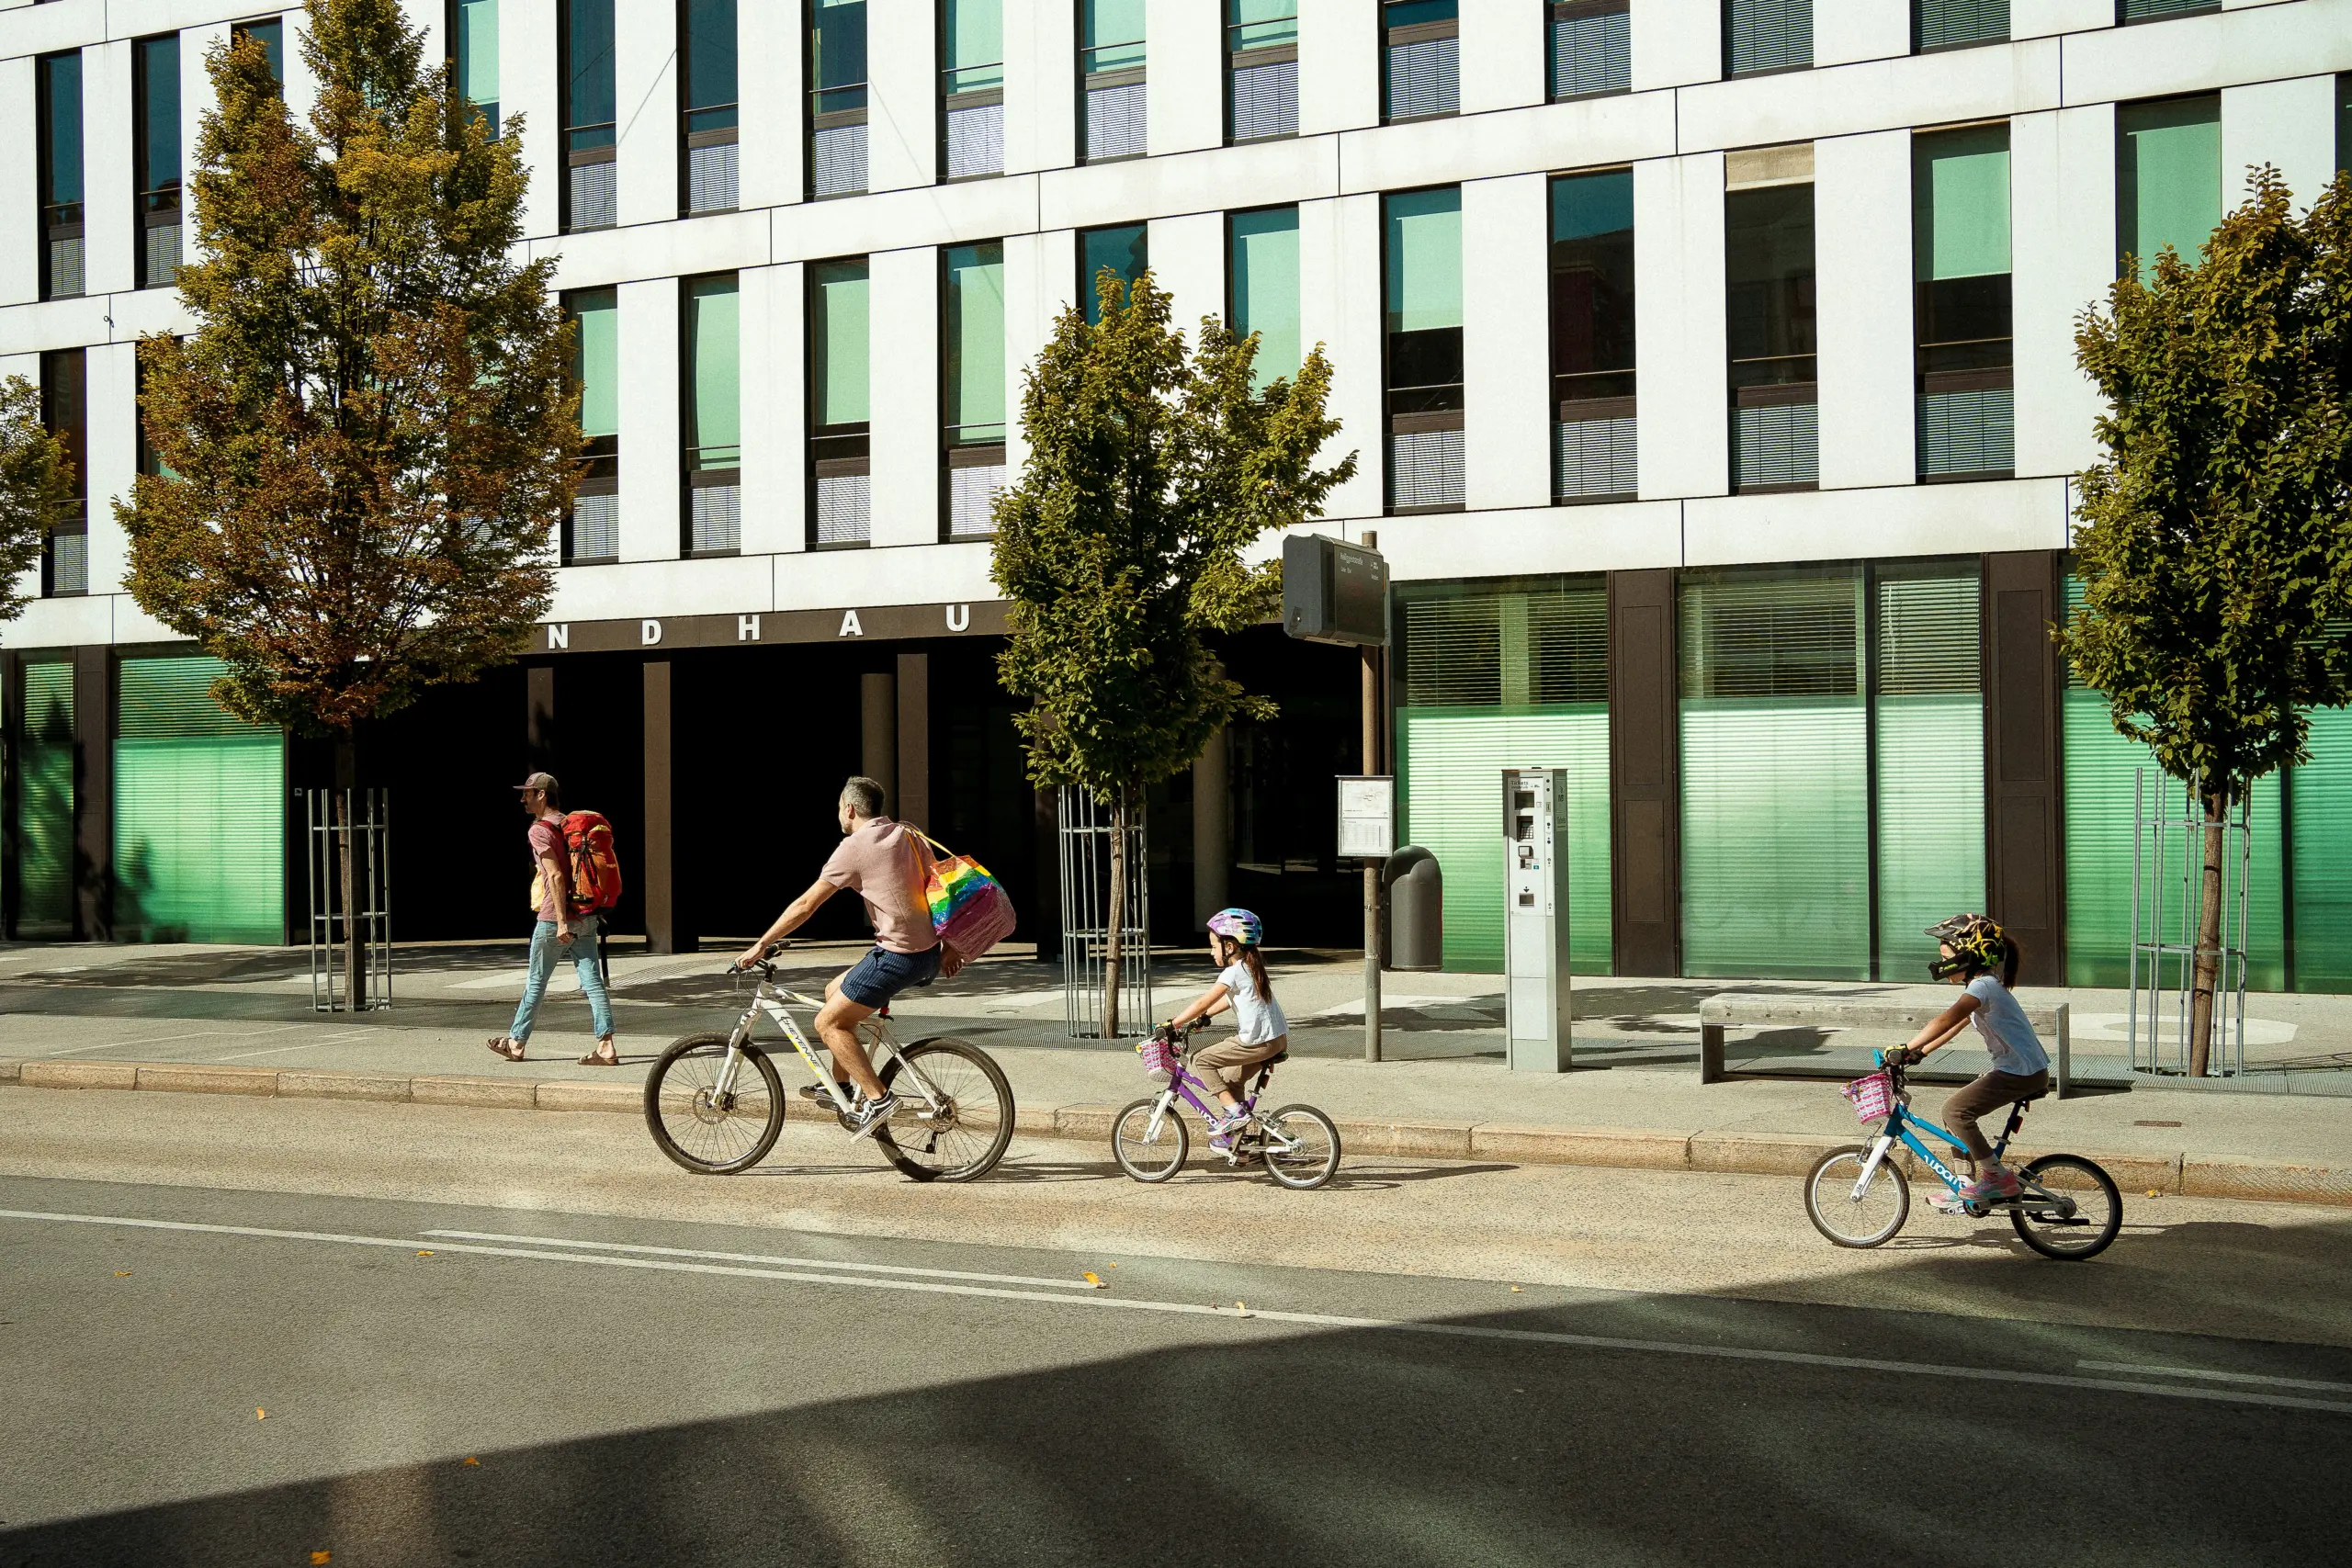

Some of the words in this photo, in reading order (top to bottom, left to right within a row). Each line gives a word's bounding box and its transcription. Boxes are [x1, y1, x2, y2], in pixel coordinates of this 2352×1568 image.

[548, 604, 970, 649] NDHAU
[781, 1016, 821, 1068] CHEYENNE
[1196, 1106, 1218, 1127] woo
